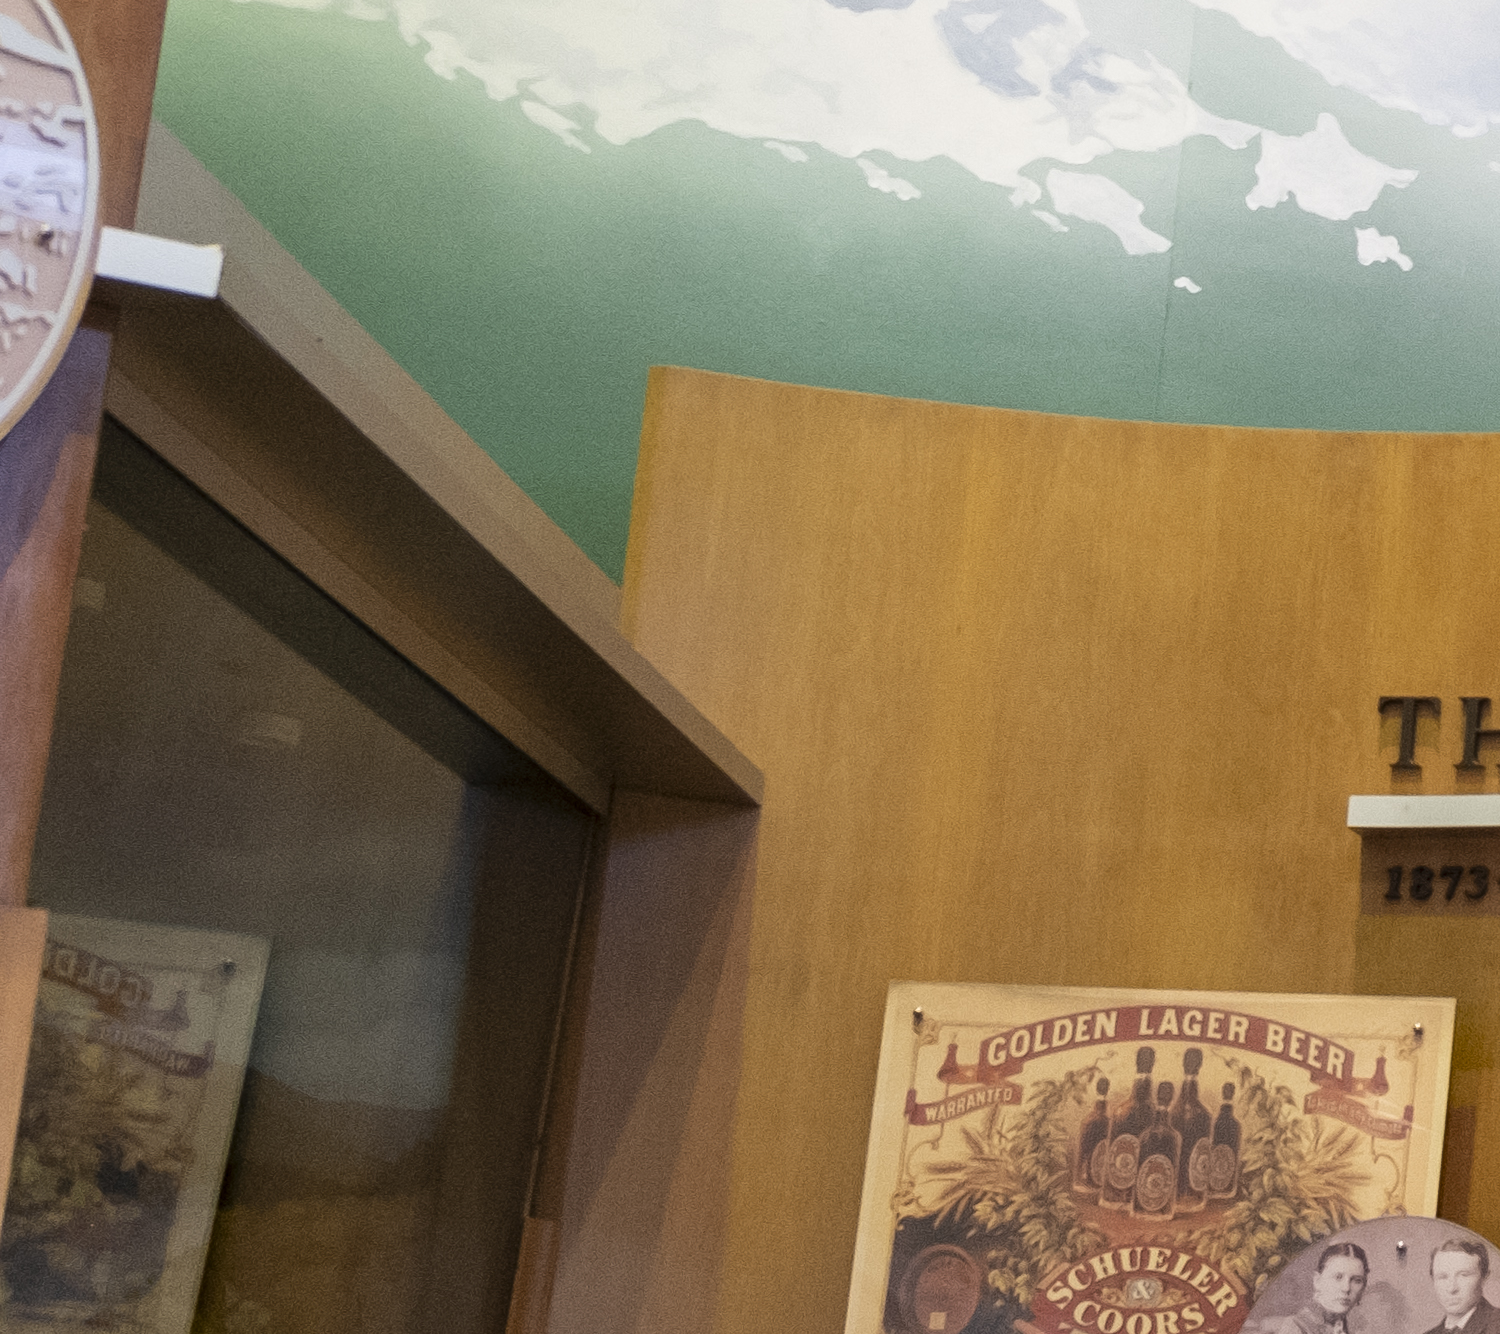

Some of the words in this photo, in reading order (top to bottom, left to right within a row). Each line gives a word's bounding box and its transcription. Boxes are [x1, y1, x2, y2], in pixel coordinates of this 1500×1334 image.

[987, 1009, 1118, 1066] GOLDEN
[1138, 1007, 1250, 1045] LAGER
[1265, 1018, 1348, 1080] BEER
[925, 1086, 1014, 1122] WARRANTED
[1045, 1247, 1240, 1318] SCHUELER
[1132, 1278, 1156, 1303] &
